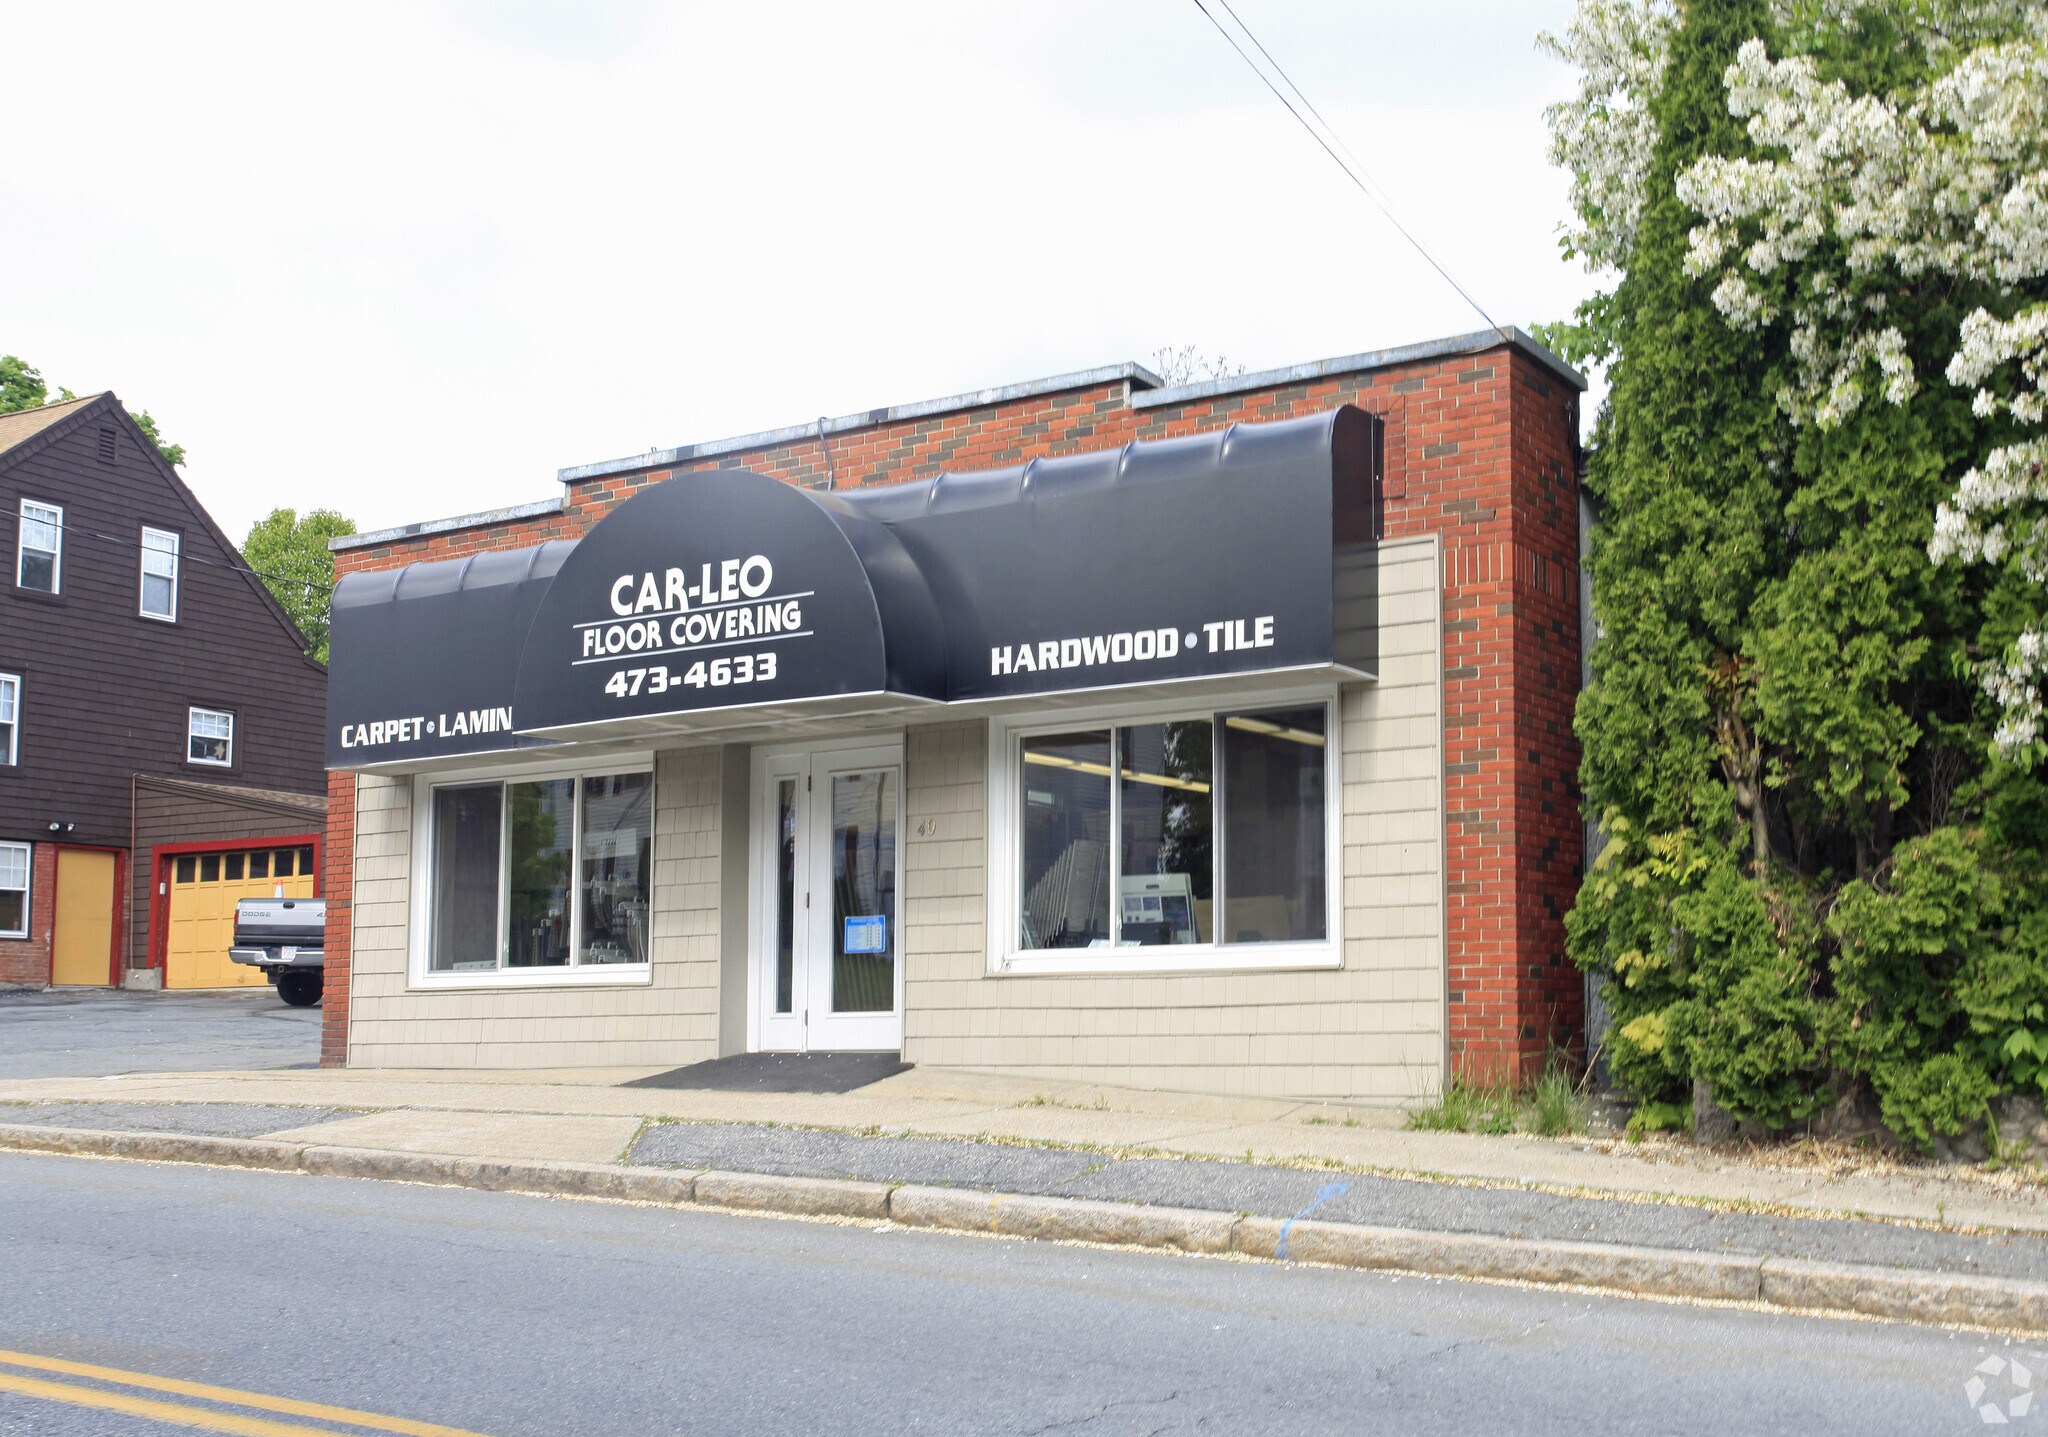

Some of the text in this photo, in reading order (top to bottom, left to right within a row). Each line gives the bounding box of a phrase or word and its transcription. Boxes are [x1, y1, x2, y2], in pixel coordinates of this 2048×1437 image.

[610, 554, 773, 617] CAR-LEO
[582, 600, 802, 658] FLOOR COVERING
[991, 615, 1275, 676] HARDWOOD TILE
[604, 652, 778, 698] 473-4633
[340, 705, 513, 749] CARPET LAMIN
[917, 819, 937, 836] 40
